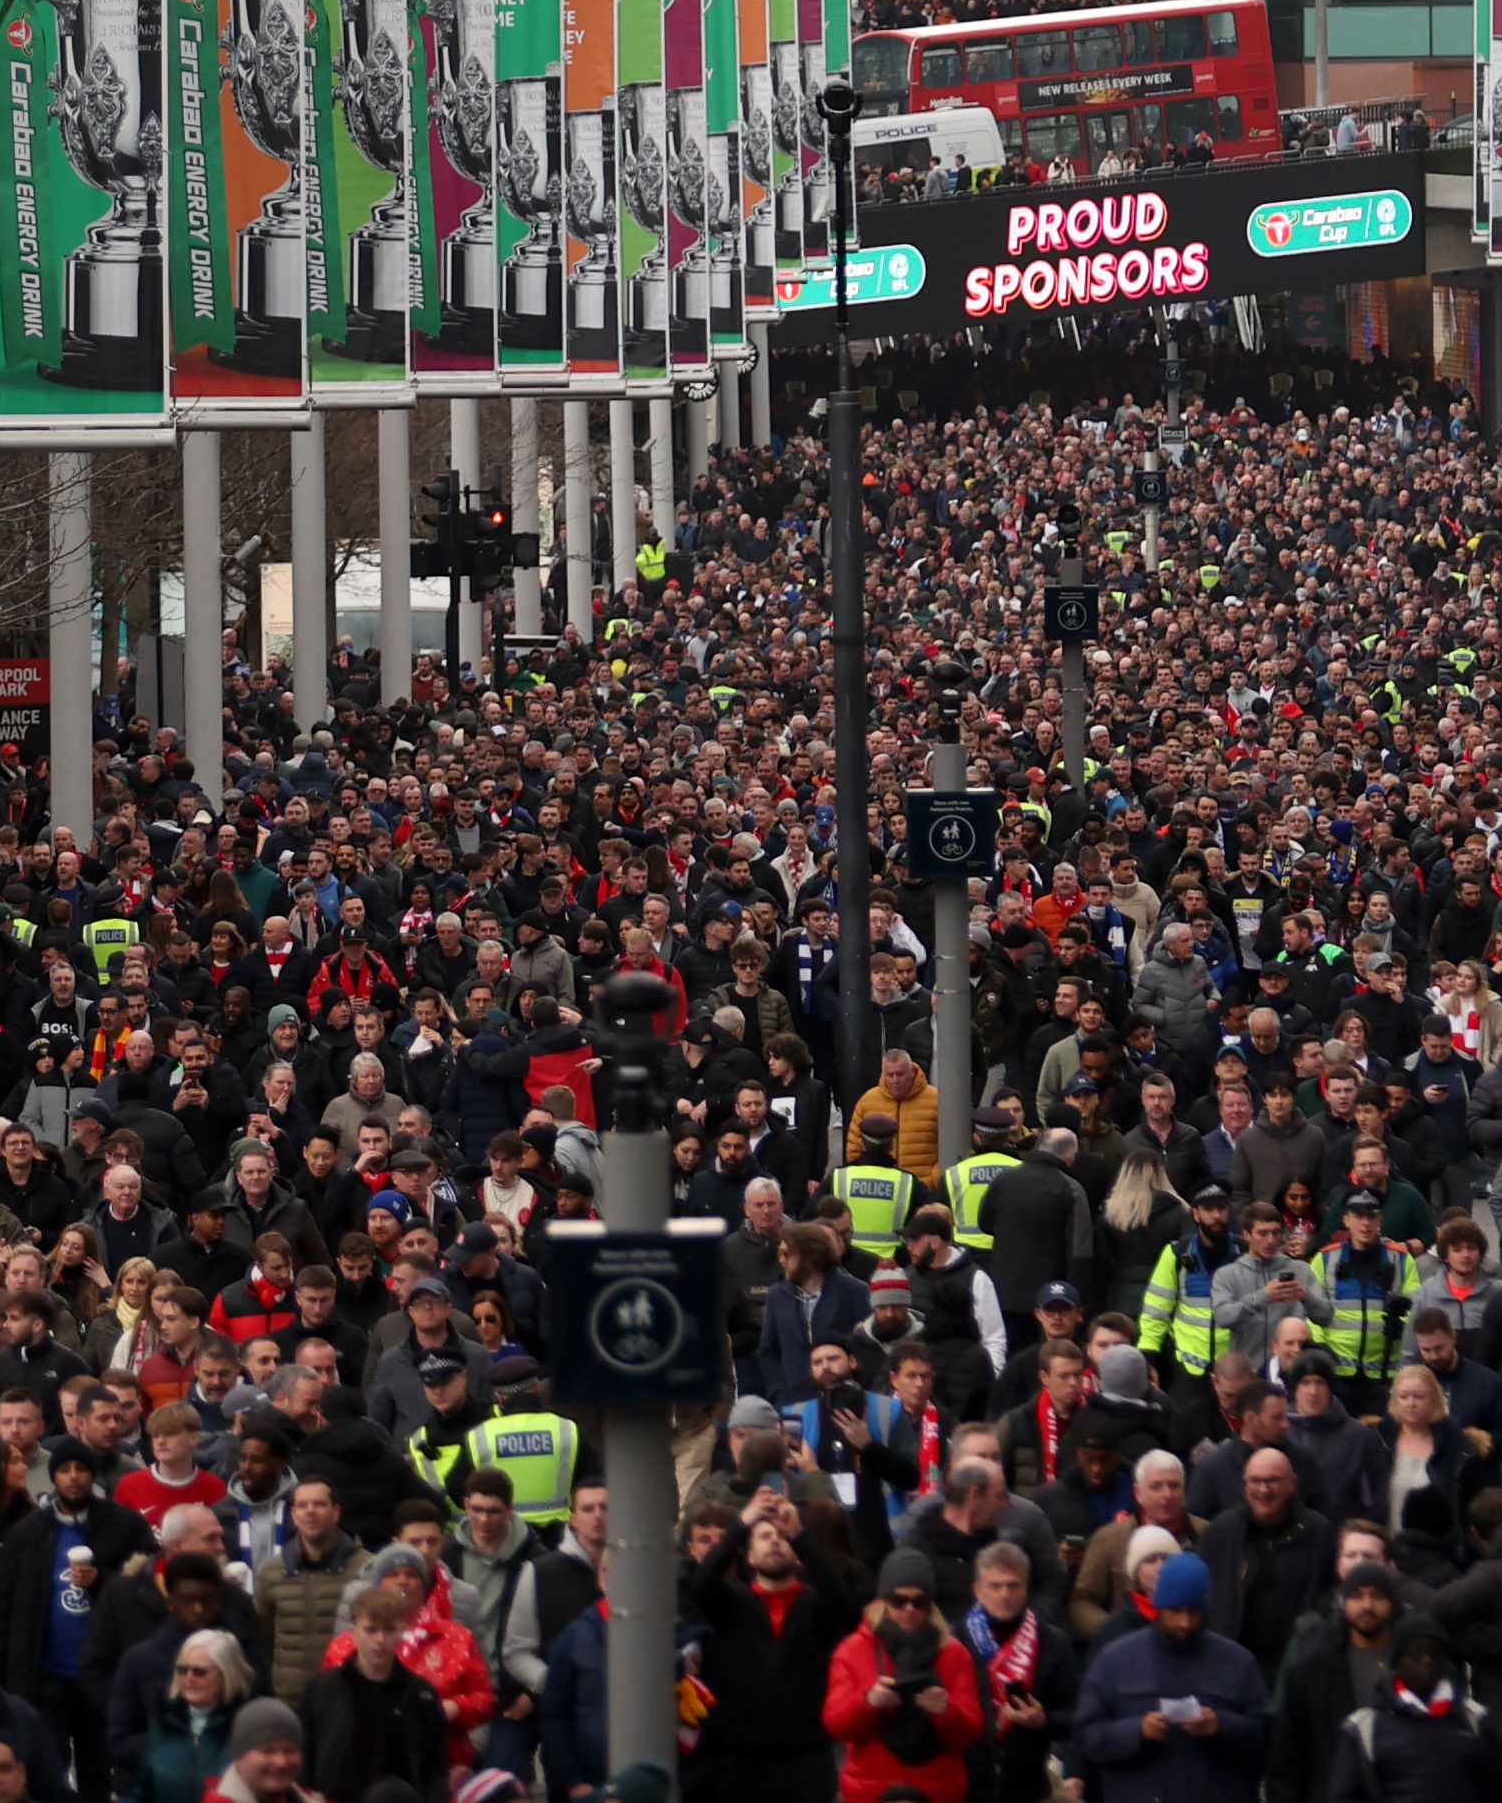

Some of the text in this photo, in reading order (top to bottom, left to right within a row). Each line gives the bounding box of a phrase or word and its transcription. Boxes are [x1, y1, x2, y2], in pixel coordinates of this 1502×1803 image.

[1038, 72, 1173, 97] NEW RELEASES EVERY WEEK
[875, 123, 938, 140] POLICE
[179, 18, 216, 320] Carabao ENERGY DRINK
[1, 60, 45, 339] Carabao ENERGY DRINK
[1006, 191, 1168, 257] PROUD
[1301, 205, 1363, 227] Carabao
[1318, 224, 1349, 244] Cup
[307, 249, 329, 314] DRINK
[964, 241, 1210, 319] SPONSORS
[96, 930, 125, 942] POLICE
[851, 1179, 893, 1198] POLICE
[496, 1432, 552, 1455] POLICE
